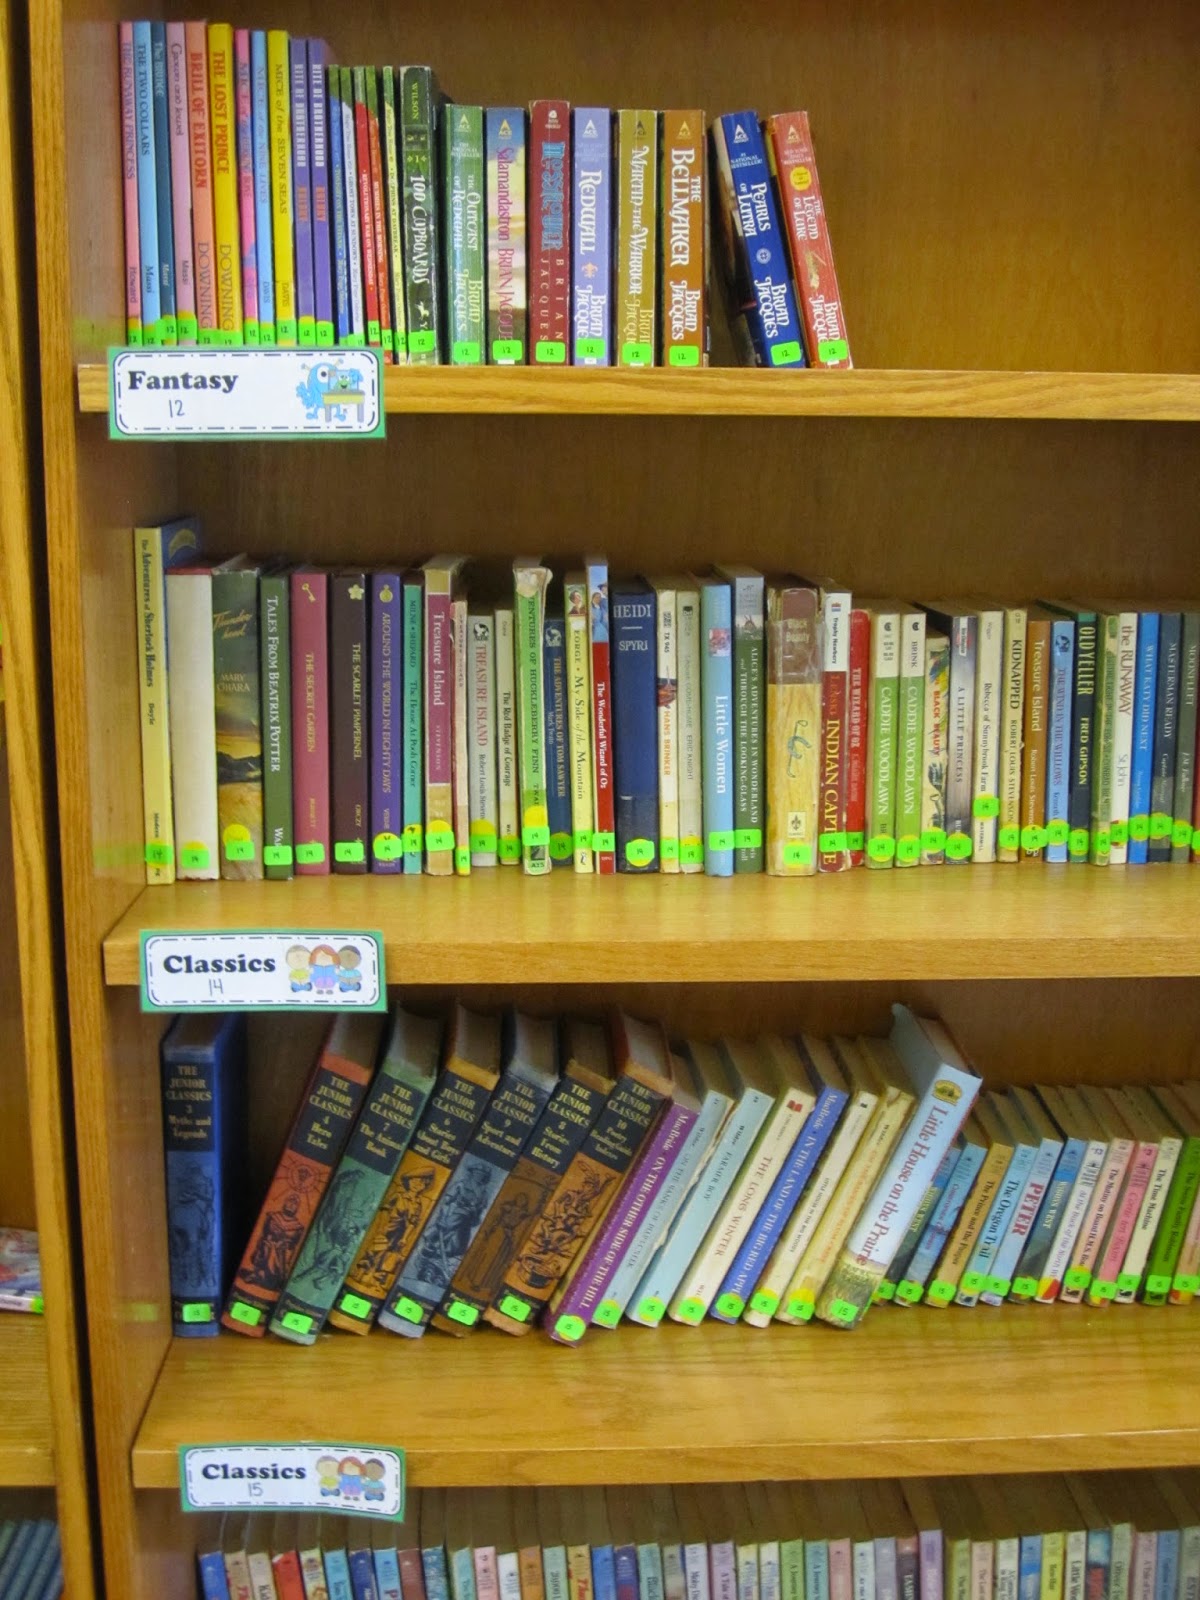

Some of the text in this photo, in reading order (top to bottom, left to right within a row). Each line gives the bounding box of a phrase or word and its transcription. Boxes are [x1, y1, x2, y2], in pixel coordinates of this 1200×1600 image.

[123, 41, 135, 179] THE RUNAWAY PRINCESS
[137, 44, 150, 155] THE TWO COLLARS
[170, 43, 184, 136] Crown and Jewel
[213, 51, 229, 174] THE LOST PRINCE
[411, 83, 420, 119] WILSON
[190, 52, 208, 188] BRILL OF EXITORN
[275, 64, 288, 214] MICE of the SEVEN SEAS
[453, 176, 465, 250] OF REDWALL
[496, 147, 516, 288] Salamandastron BRIAN
[578, 170, 602, 255] REDWALL
[670, 148, 695, 267] BELLMAKER
[691, 176, 701, 202] THE
[737, 183, 754, 237] OF LUTRA
[751, 182, 771, 232] PEARLS
[793, 197, 801, 209] OF
[803, 195, 819, 240] LEGEND
[410, 174, 430, 284] 100 CUPBOARDS
[466, 192, 481, 251] OUTCAST
[629, 146, 649, 295] MARTIN THE WARRIOR
[794, 210, 807, 241] LUKE
[129, 266, 138, 303] Howard
[197, 242, 212, 328] DOWNING
[218, 244, 234, 331] DOWNING
[454, 269, 469, 331] JACQUES
[468, 279, 482, 322] BRIAN
[538, 258, 549, 341] JACQUES
[555, 258, 564, 340] BRIAN
[670, 280, 685, 340] JACQUES
[683, 290, 700, 332] BRIAN
[754, 276, 778, 338] JACQUES
[771, 283, 790, 326] BRIAN
[590, 294, 607, 336] BRIAN
[824, 301, 840, 342] BRIAN
[127, 370, 239, 394] Fantasy
[168, 399, 185, 418] 12
[142, 552, 156, 602] Adventures
[144, 612, 156, 652] Sherlock
[613, 605, 652, 618] HEIDI
[145, 654, 157, 687] Holmes
[433, 612, 445, 705] Treasure Island
[618, 640, 649, 650] SPYRI
[750, 646, 758, 681] ALICE'S
[1010, 639, 1022, 709] KIDNAPPED
[1077, 627, 1094, 695] OLD YELLER
[1118, 625, 1134, 715] the RUNAWAY
[267, 596, 282, 771] TALES FROM BEATRIX POTTER
[306, 653, 315, 752] THE SECRET GARDEN
[352, 643, 362, 760] THE SCARLET PIMPERNEL
[382, 613, 391, 793] AROUND THE WORLD IN EIGHTY DAYS
[476, 645, 488, 746] TREASURE ISLAND
[571, 675, 584, 695] My
[574, 698, 586, 720] Side
[1031, 639, 1044, 731] Treasure Island
[148, 703, 156, 725] Doyle
[575, 734, 585, 746] the
[596, 682, 607, 788] The Wonderful Wizard of Oz
[663, 711, 672, 776] HANS BRINKER
[715, 695, 728, 794] Little Women
[751, 746, 758, 757] IN
[878, 686, 892, 815] CADDIE WOODLAWN
[904, 686, 918, 814] CADDIE WOODLAWN
[1078, 717, 1090, 785] FRED GIPSON
[575, 750, 587, 800] Mountain
[750, 759, 758, 823] WONDERLAND
[1007, 778, 1015, 822] STEVENSON
[163, 953, 276, 974] Classics
[208, 978, 224, 996] 14
[548, 1103, 591, 1128] CLASSICS
[556, 1092, 593, 1115] JUNIOR
[570, 1082, 591, 1100] THE
[578, 1111, 688, 1311] MacBride ON THE OTHER SIDE OF THE HILL
[713, 1153, 773, 1259] THE LONG WINTER
[856, 1105, 948, 1266] Little House on the Prairie
[1002, 1177, 1019, 1199] The
[1010, 1182, 1044, 1238] PETER
[984, 1196, 1012, 1237] Oregon
[202, 1463, 306, 1480] Classics
[247, 1482, 263, 1497] 15
